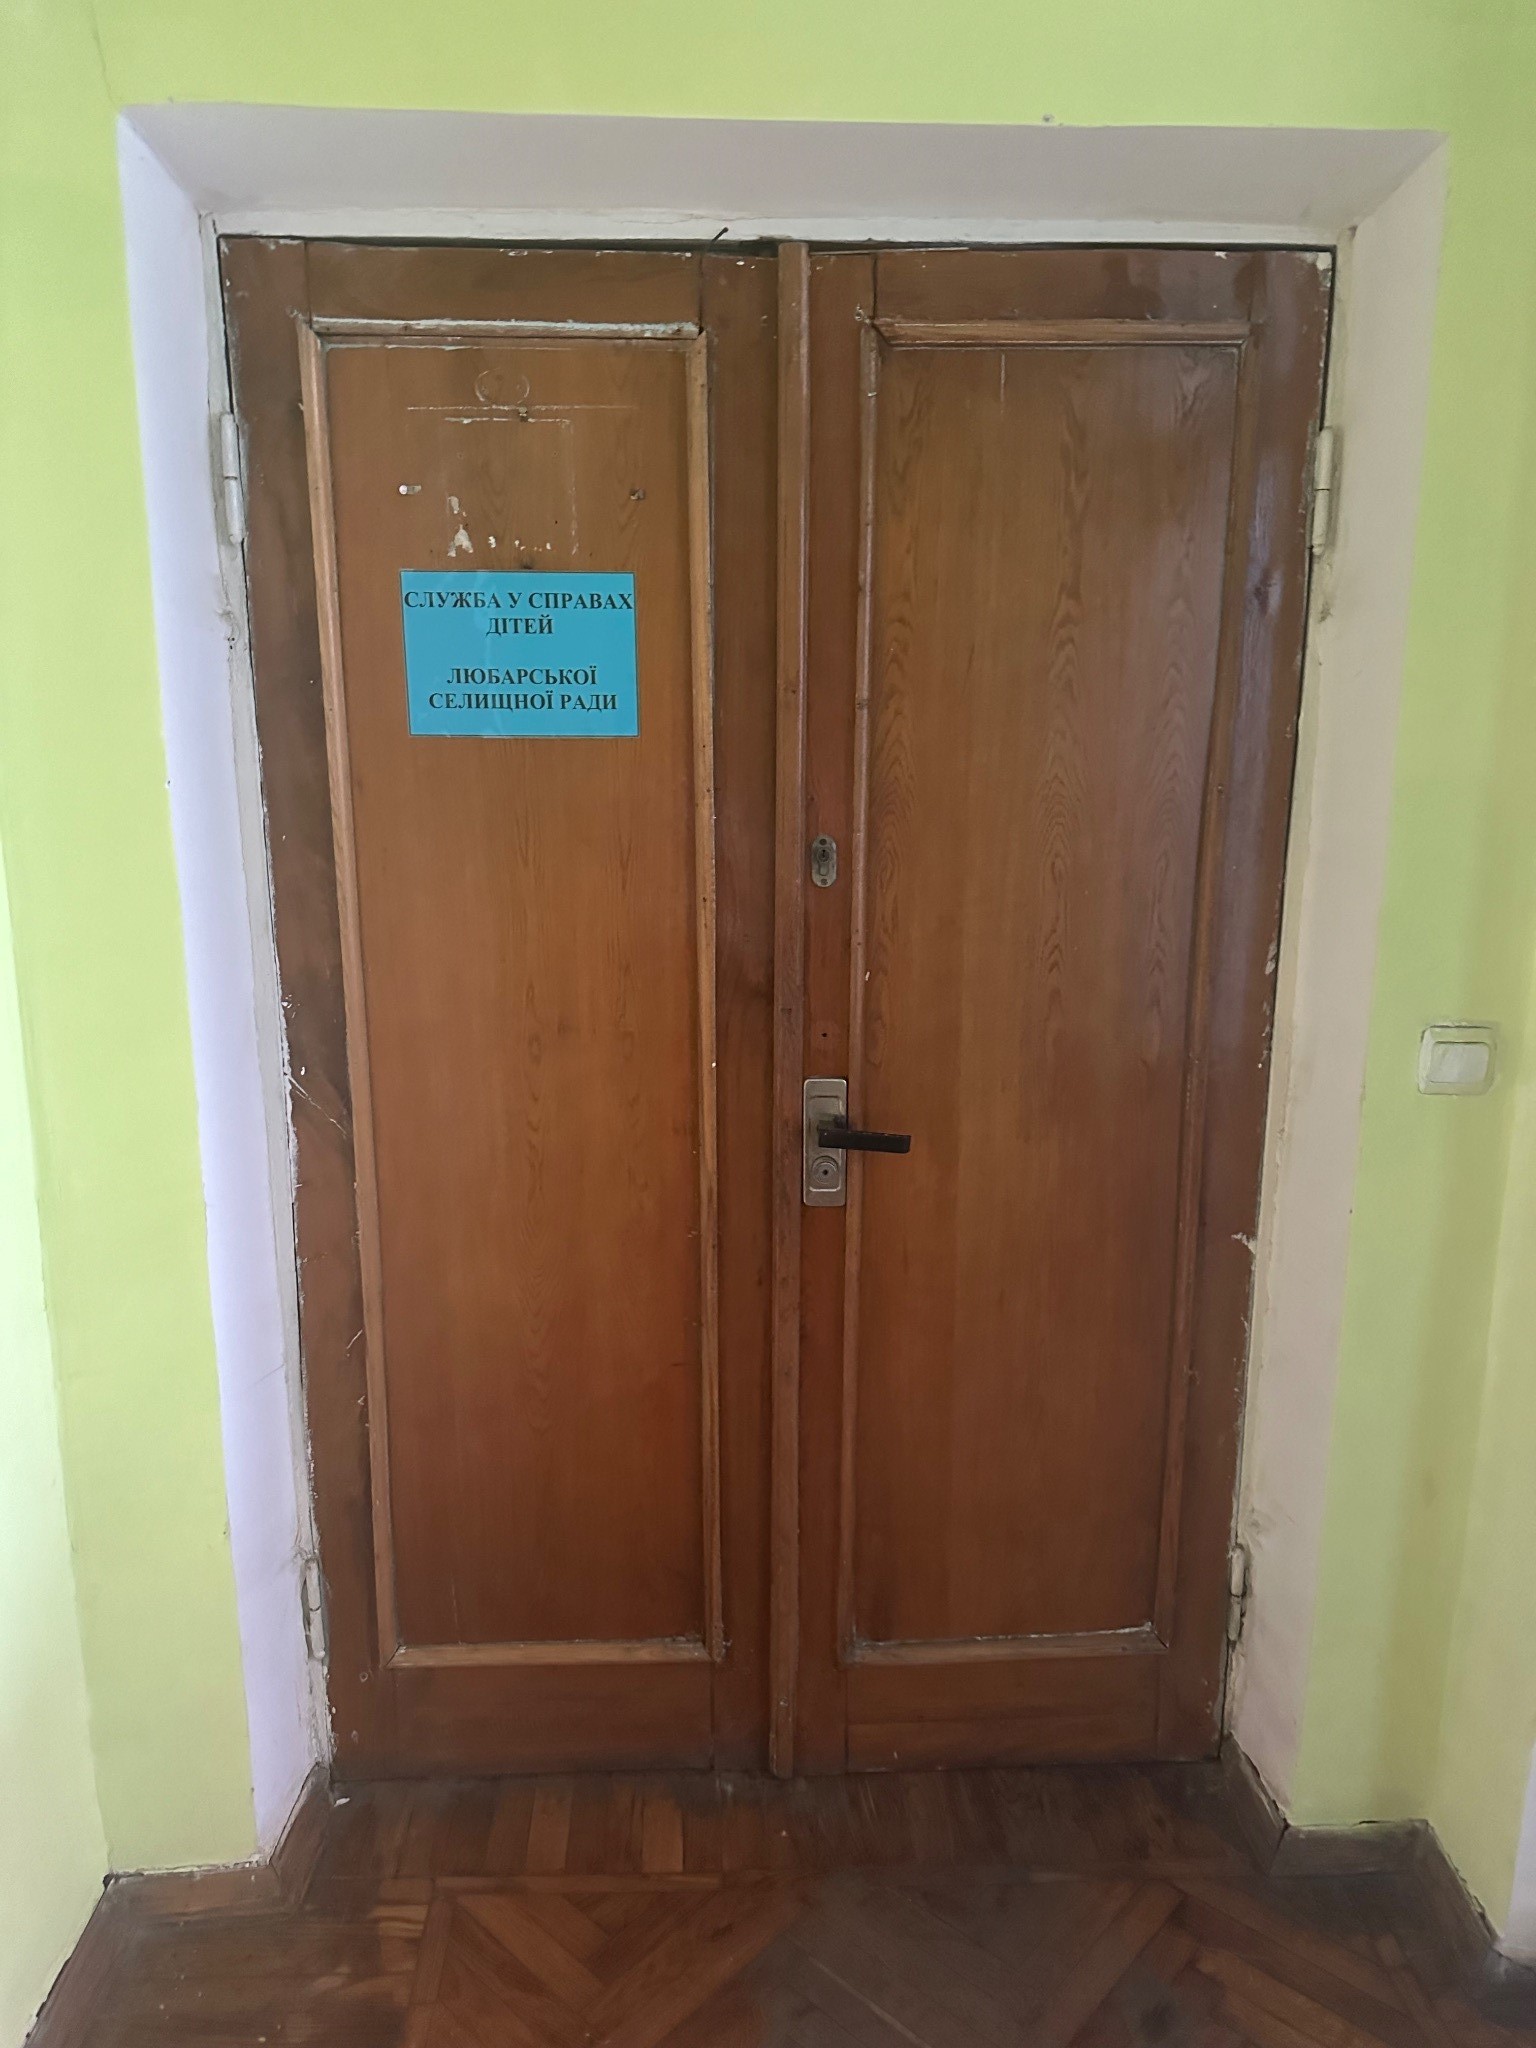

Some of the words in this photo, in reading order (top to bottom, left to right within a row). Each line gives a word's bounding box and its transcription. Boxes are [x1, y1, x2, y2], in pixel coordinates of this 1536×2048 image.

[404, 591, 501, 608] СЛУЖБА
[508, 592, 523, 609] У
[528, 592, 634, 610] СПРАВАХ
[486, 614, 554, 637] ДІТЕЙ
[447, 665, 597, 685] ЛЮБАРСЬКОЇ
[429, 690, 554, 712] СЕЛИЩНОЇ
[560, 693, 617, 712] РАДИ
